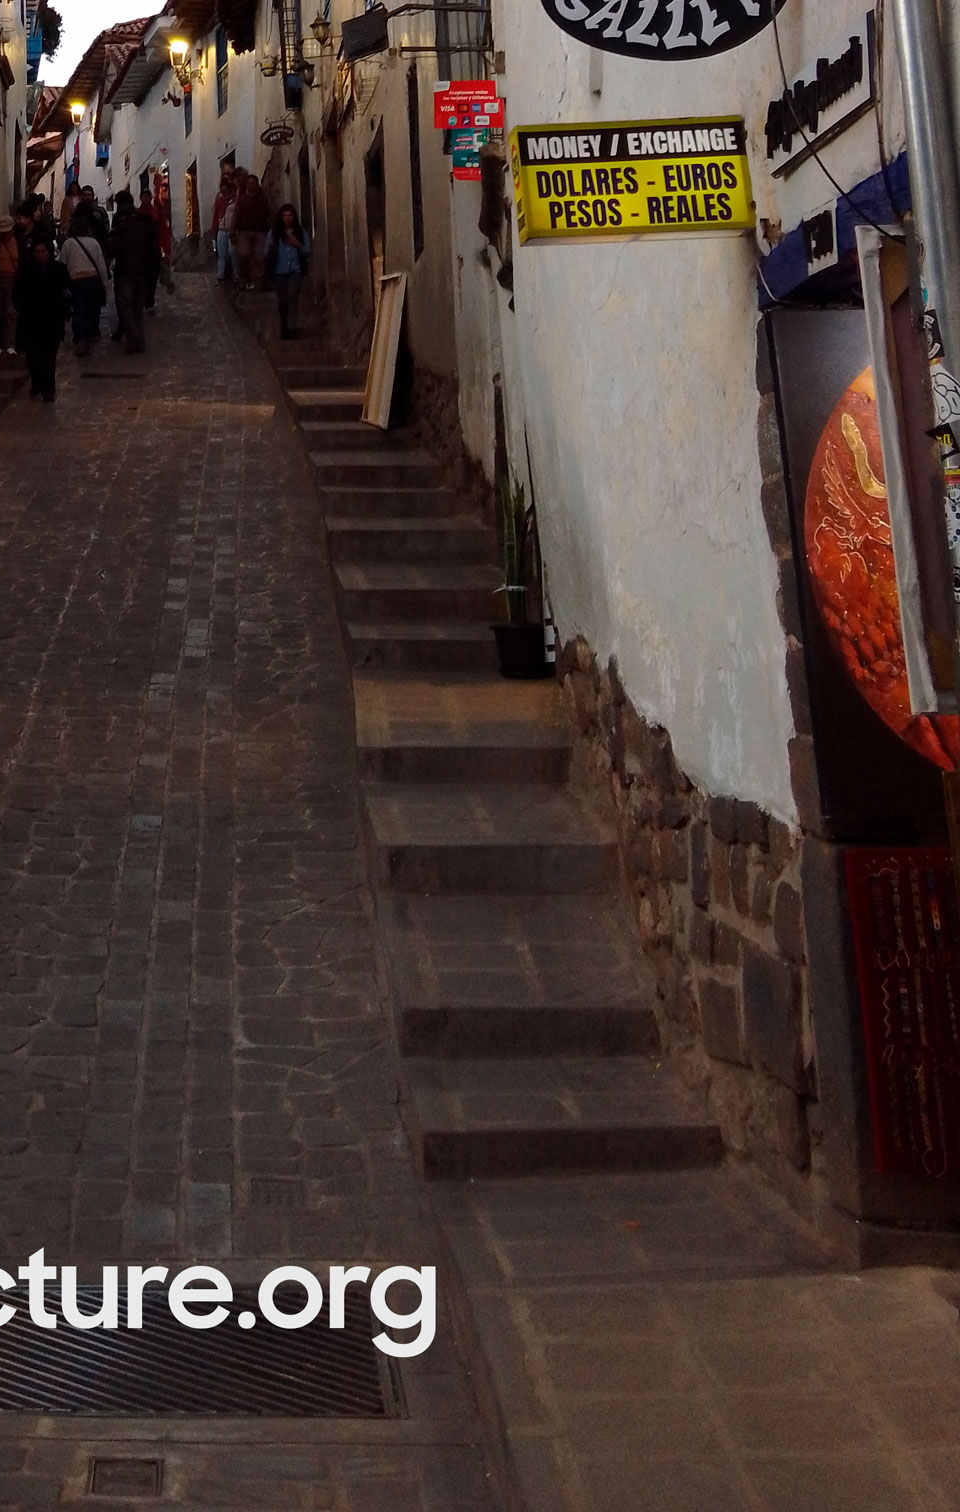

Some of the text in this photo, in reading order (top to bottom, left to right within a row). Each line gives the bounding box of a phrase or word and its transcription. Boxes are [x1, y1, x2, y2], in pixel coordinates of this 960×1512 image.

[526, 133, 602, 160] MONEY
[626, 127, 738, 156] EXCHANGE
[535, 166, 639, 199] DOLARES
[662, 161, 738, 193] EUROS
[548, 198, 623, 229] PESOS
[646, 193, 733, 225] REALES
